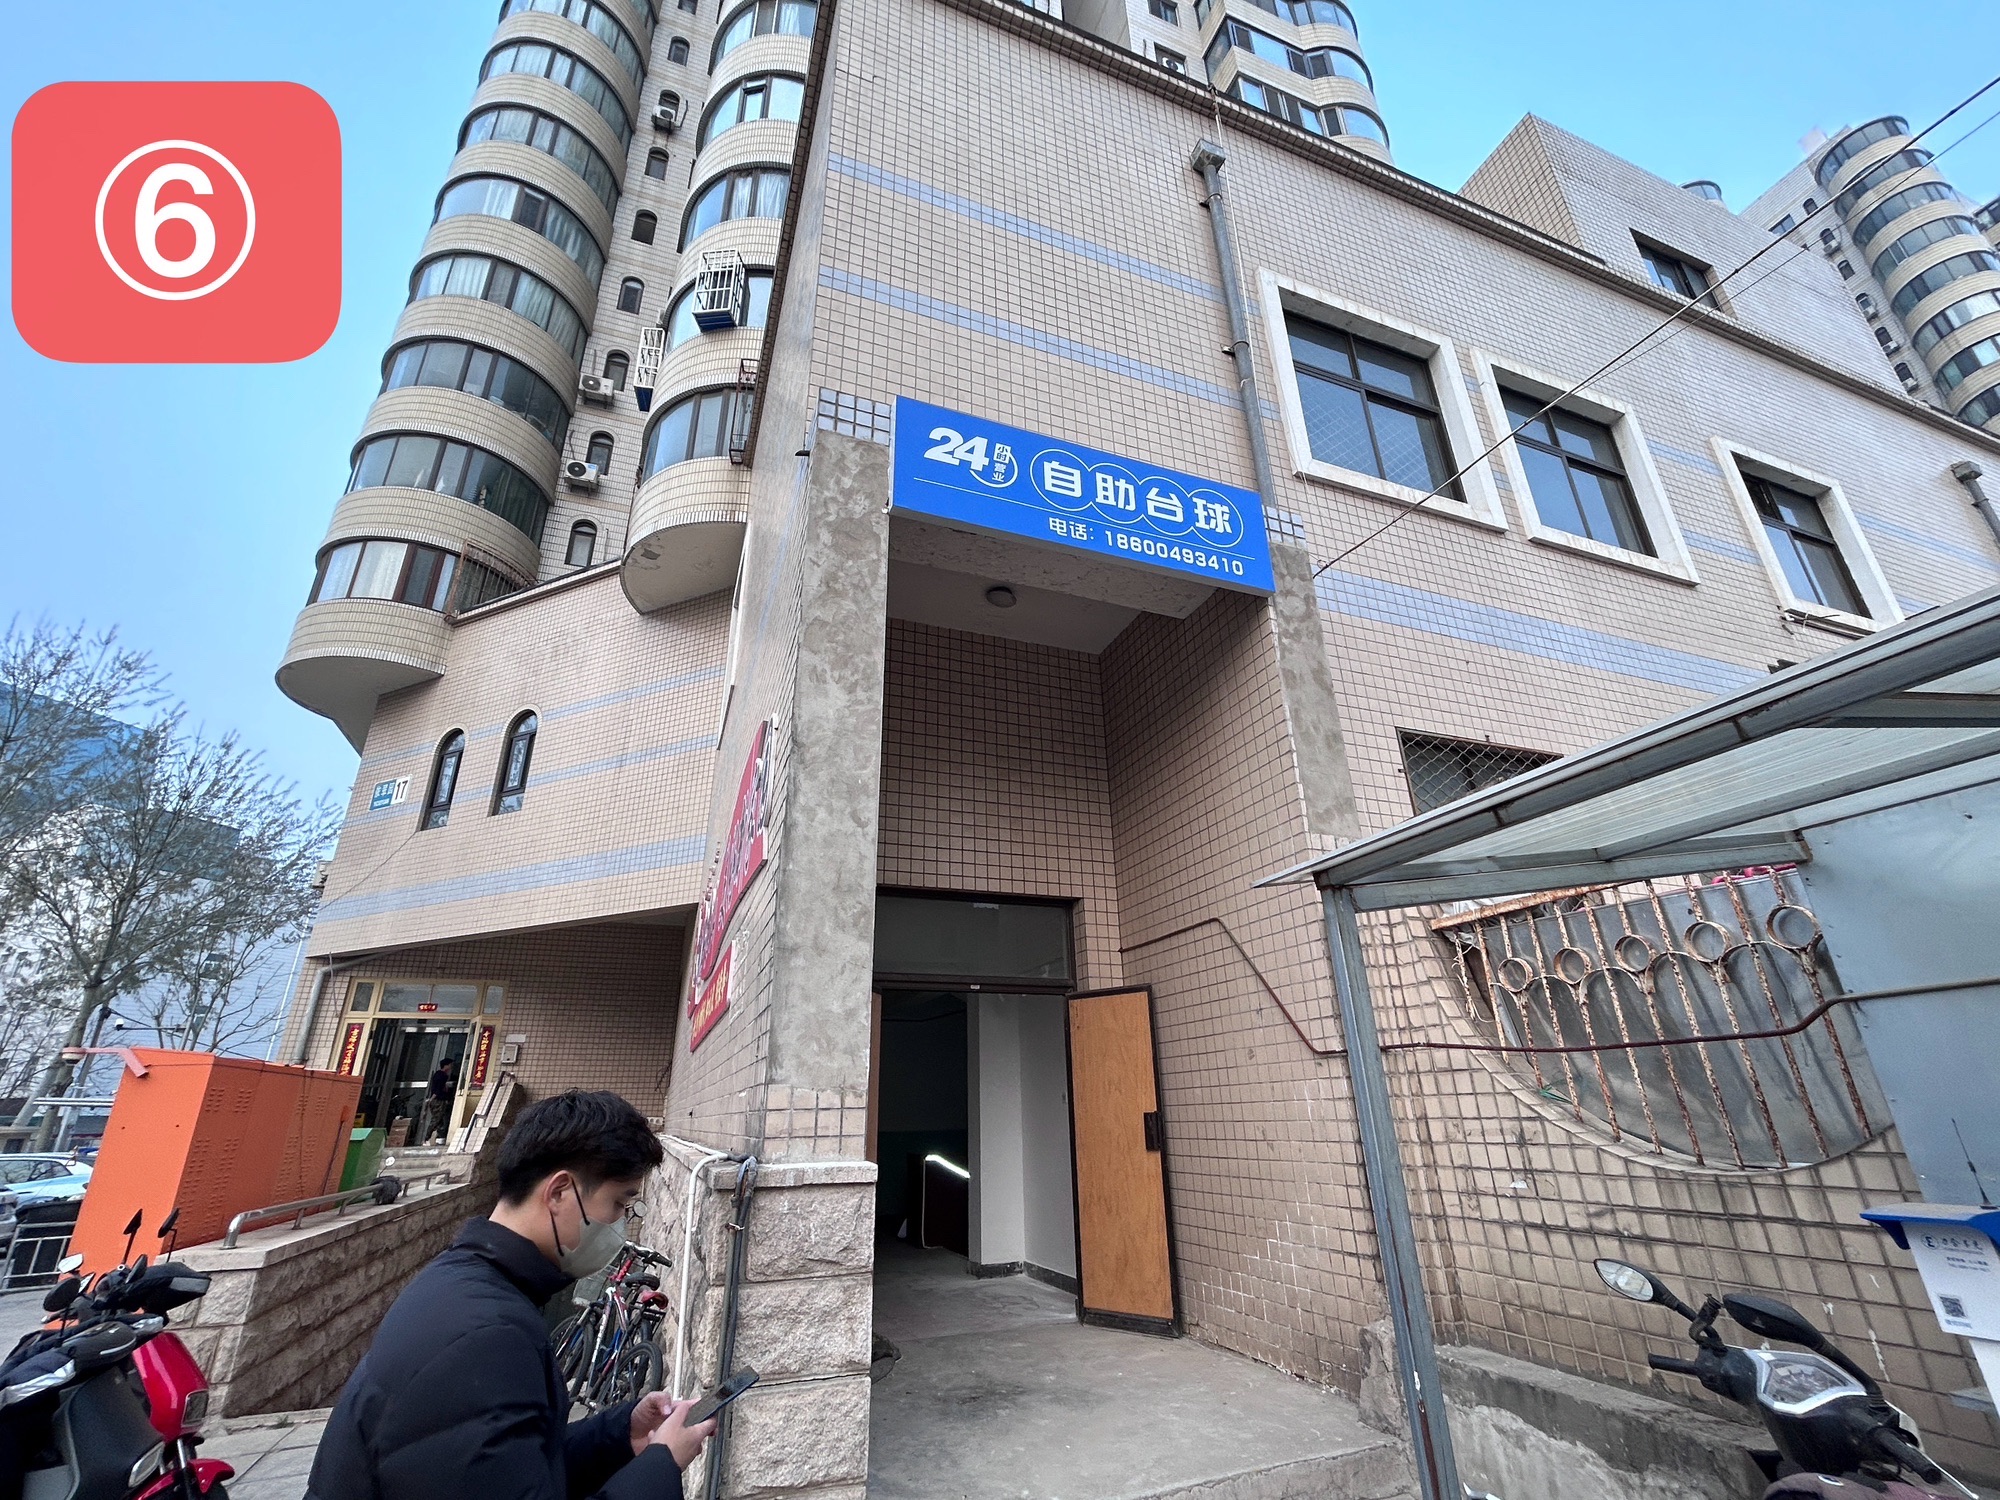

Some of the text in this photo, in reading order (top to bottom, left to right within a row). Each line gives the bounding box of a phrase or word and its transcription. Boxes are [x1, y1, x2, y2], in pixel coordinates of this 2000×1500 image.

[923, 427, 989, 471] 24
[1043, 461, 1232, 534] 自助台球
[394, 780, 408, 800] 17
